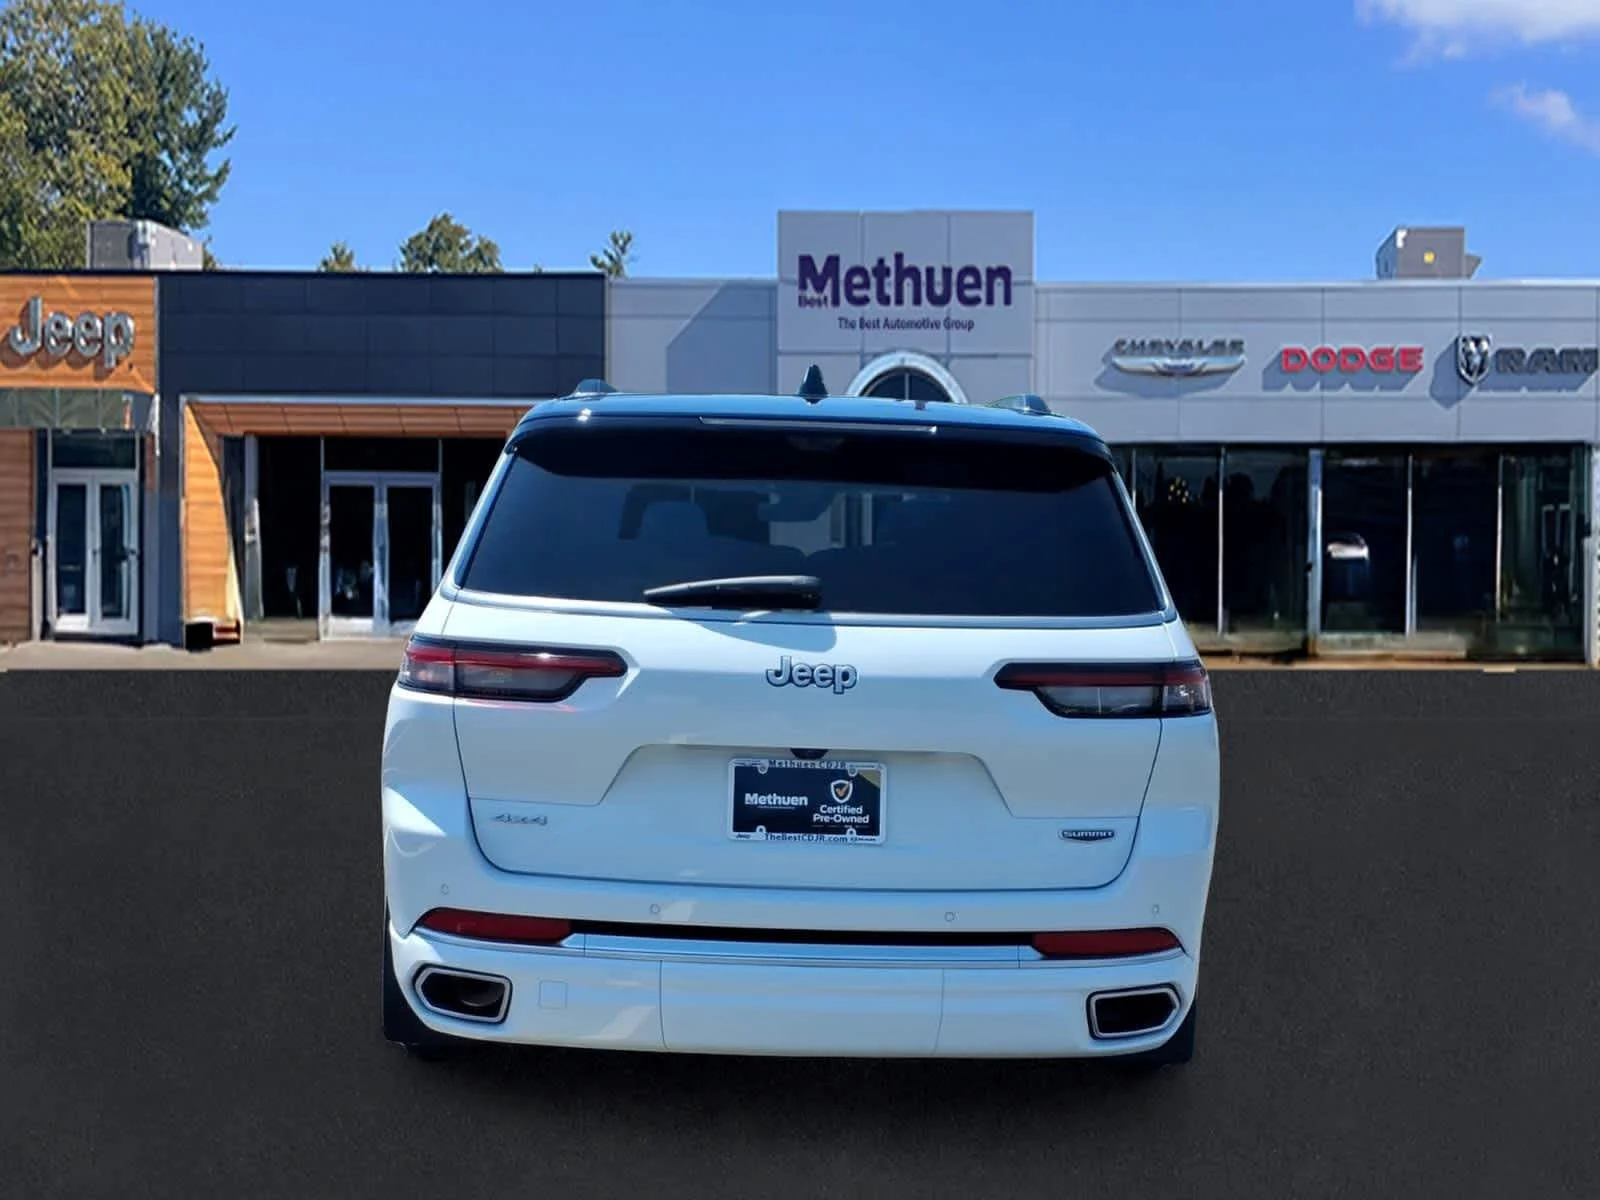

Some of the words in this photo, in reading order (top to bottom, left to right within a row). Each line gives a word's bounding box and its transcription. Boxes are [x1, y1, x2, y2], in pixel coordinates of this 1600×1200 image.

[798, 252, 1012, 307] Methuen
[9, 296, 135, 368] Jeep
[838, 317, 856, 330] The
[859, 317, 881, 330] Best
[883, 317, 941, 330] Automotive
[943, 317, 975, 332] Group
[1113, 338, 1245, 357] CHRYSLER
[1281, 346, 1424, 373] DODGE
[1495, 347, 1599, 375] RAM
[765, 656, 858, 695] Jeep
[745, 793, 808, 806] Methuen
[820, 805, 863, 814] Certified
[813, 814, 869, 823] Pre-Owned
